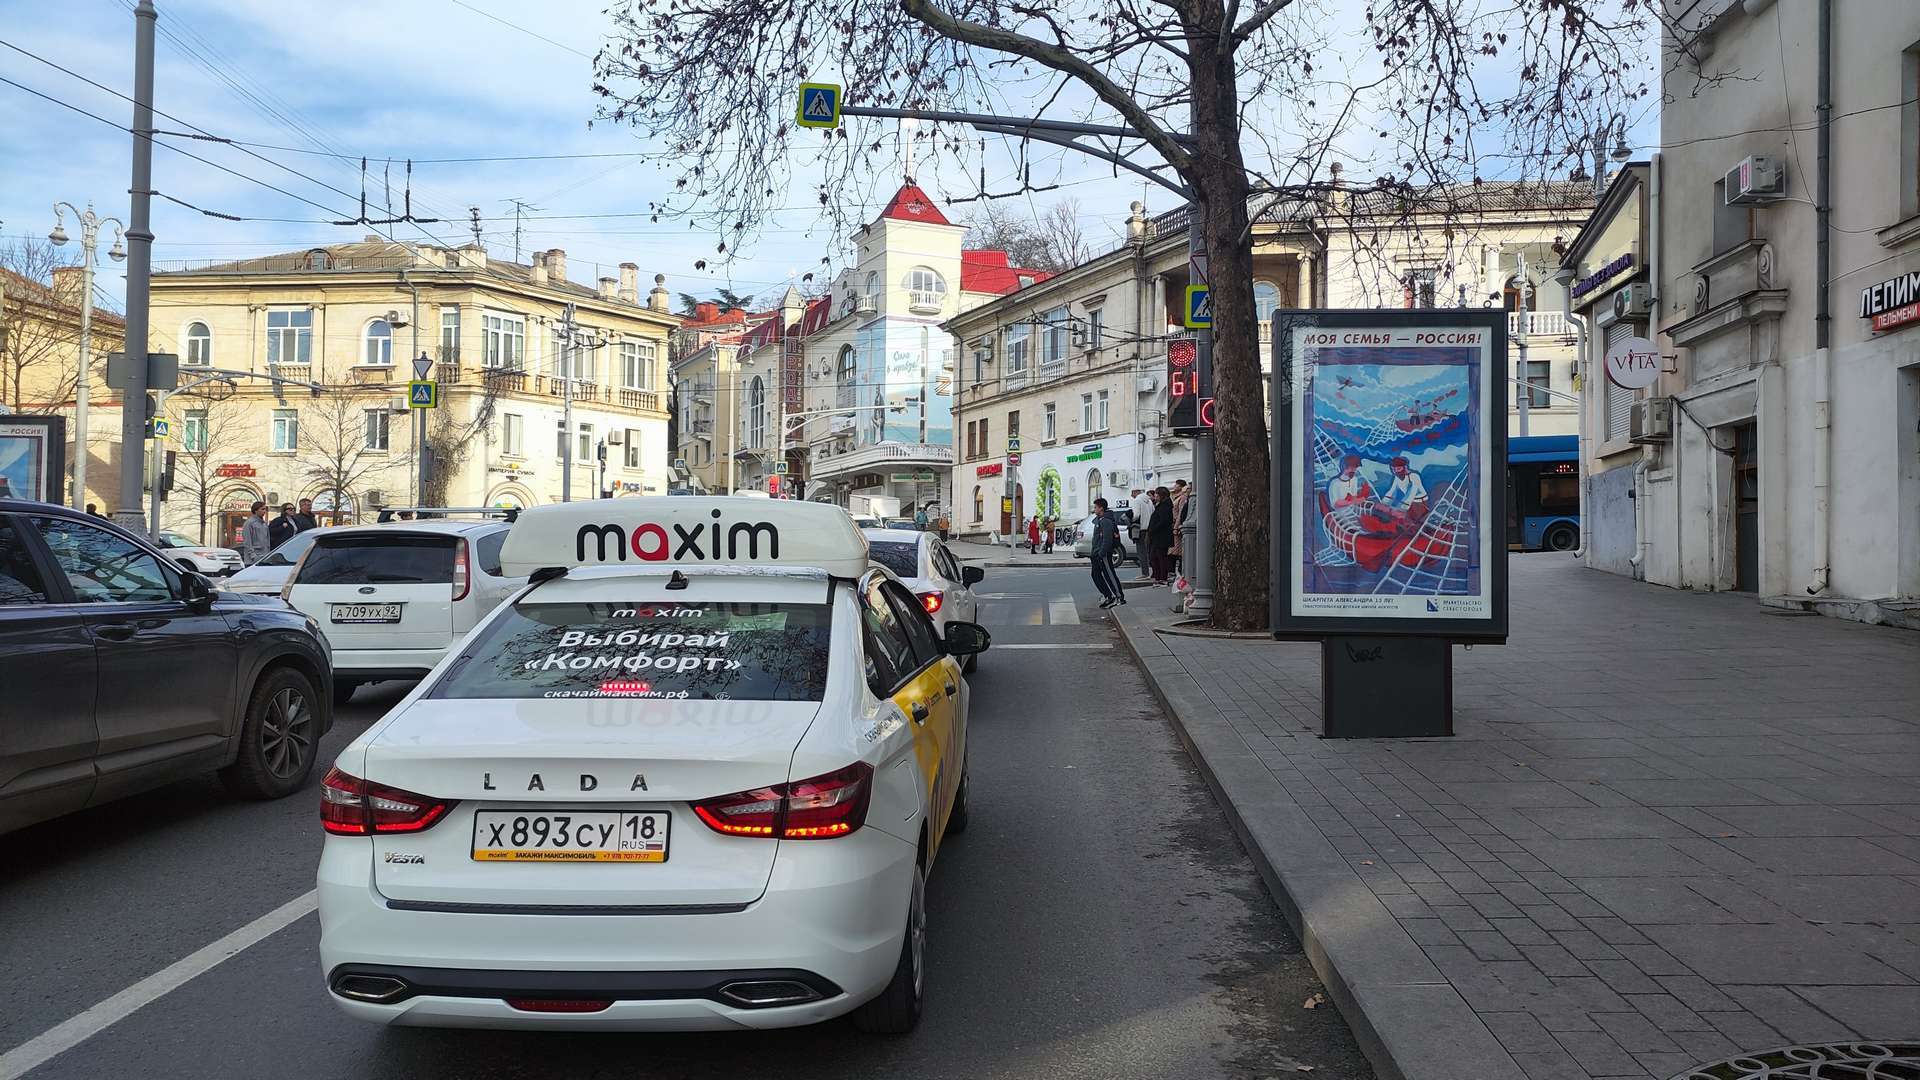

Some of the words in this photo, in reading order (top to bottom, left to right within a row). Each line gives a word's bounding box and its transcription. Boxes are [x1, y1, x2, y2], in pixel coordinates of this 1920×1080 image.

[1878, 305, 1918, 327] ПЕЛЬМЕНИ
[1304, 333, 1337, 345] МОЯ
[1343, 333, 1391, 345] СЕМЬЯ
[1415, 333, 1482, 345] РОССИЯ!
[1172, 371, 1197, 396] 61
[577, 508, 779, 561] maxim
[385, 606, 396, 614] 92
[612, 606, 703, 618] maxim
[558, 630, 731, 649] Выбирай
[524, 652, 741, 673] «Комфорт»
[544, 689, 689, 699] скачаймаксим.рф
[483, 773, 649, 792] LADA
[625, 816, 656, 839] 18
[621, 840, 646, 850] RUS
[384, 852, 425, 865] VESTA
